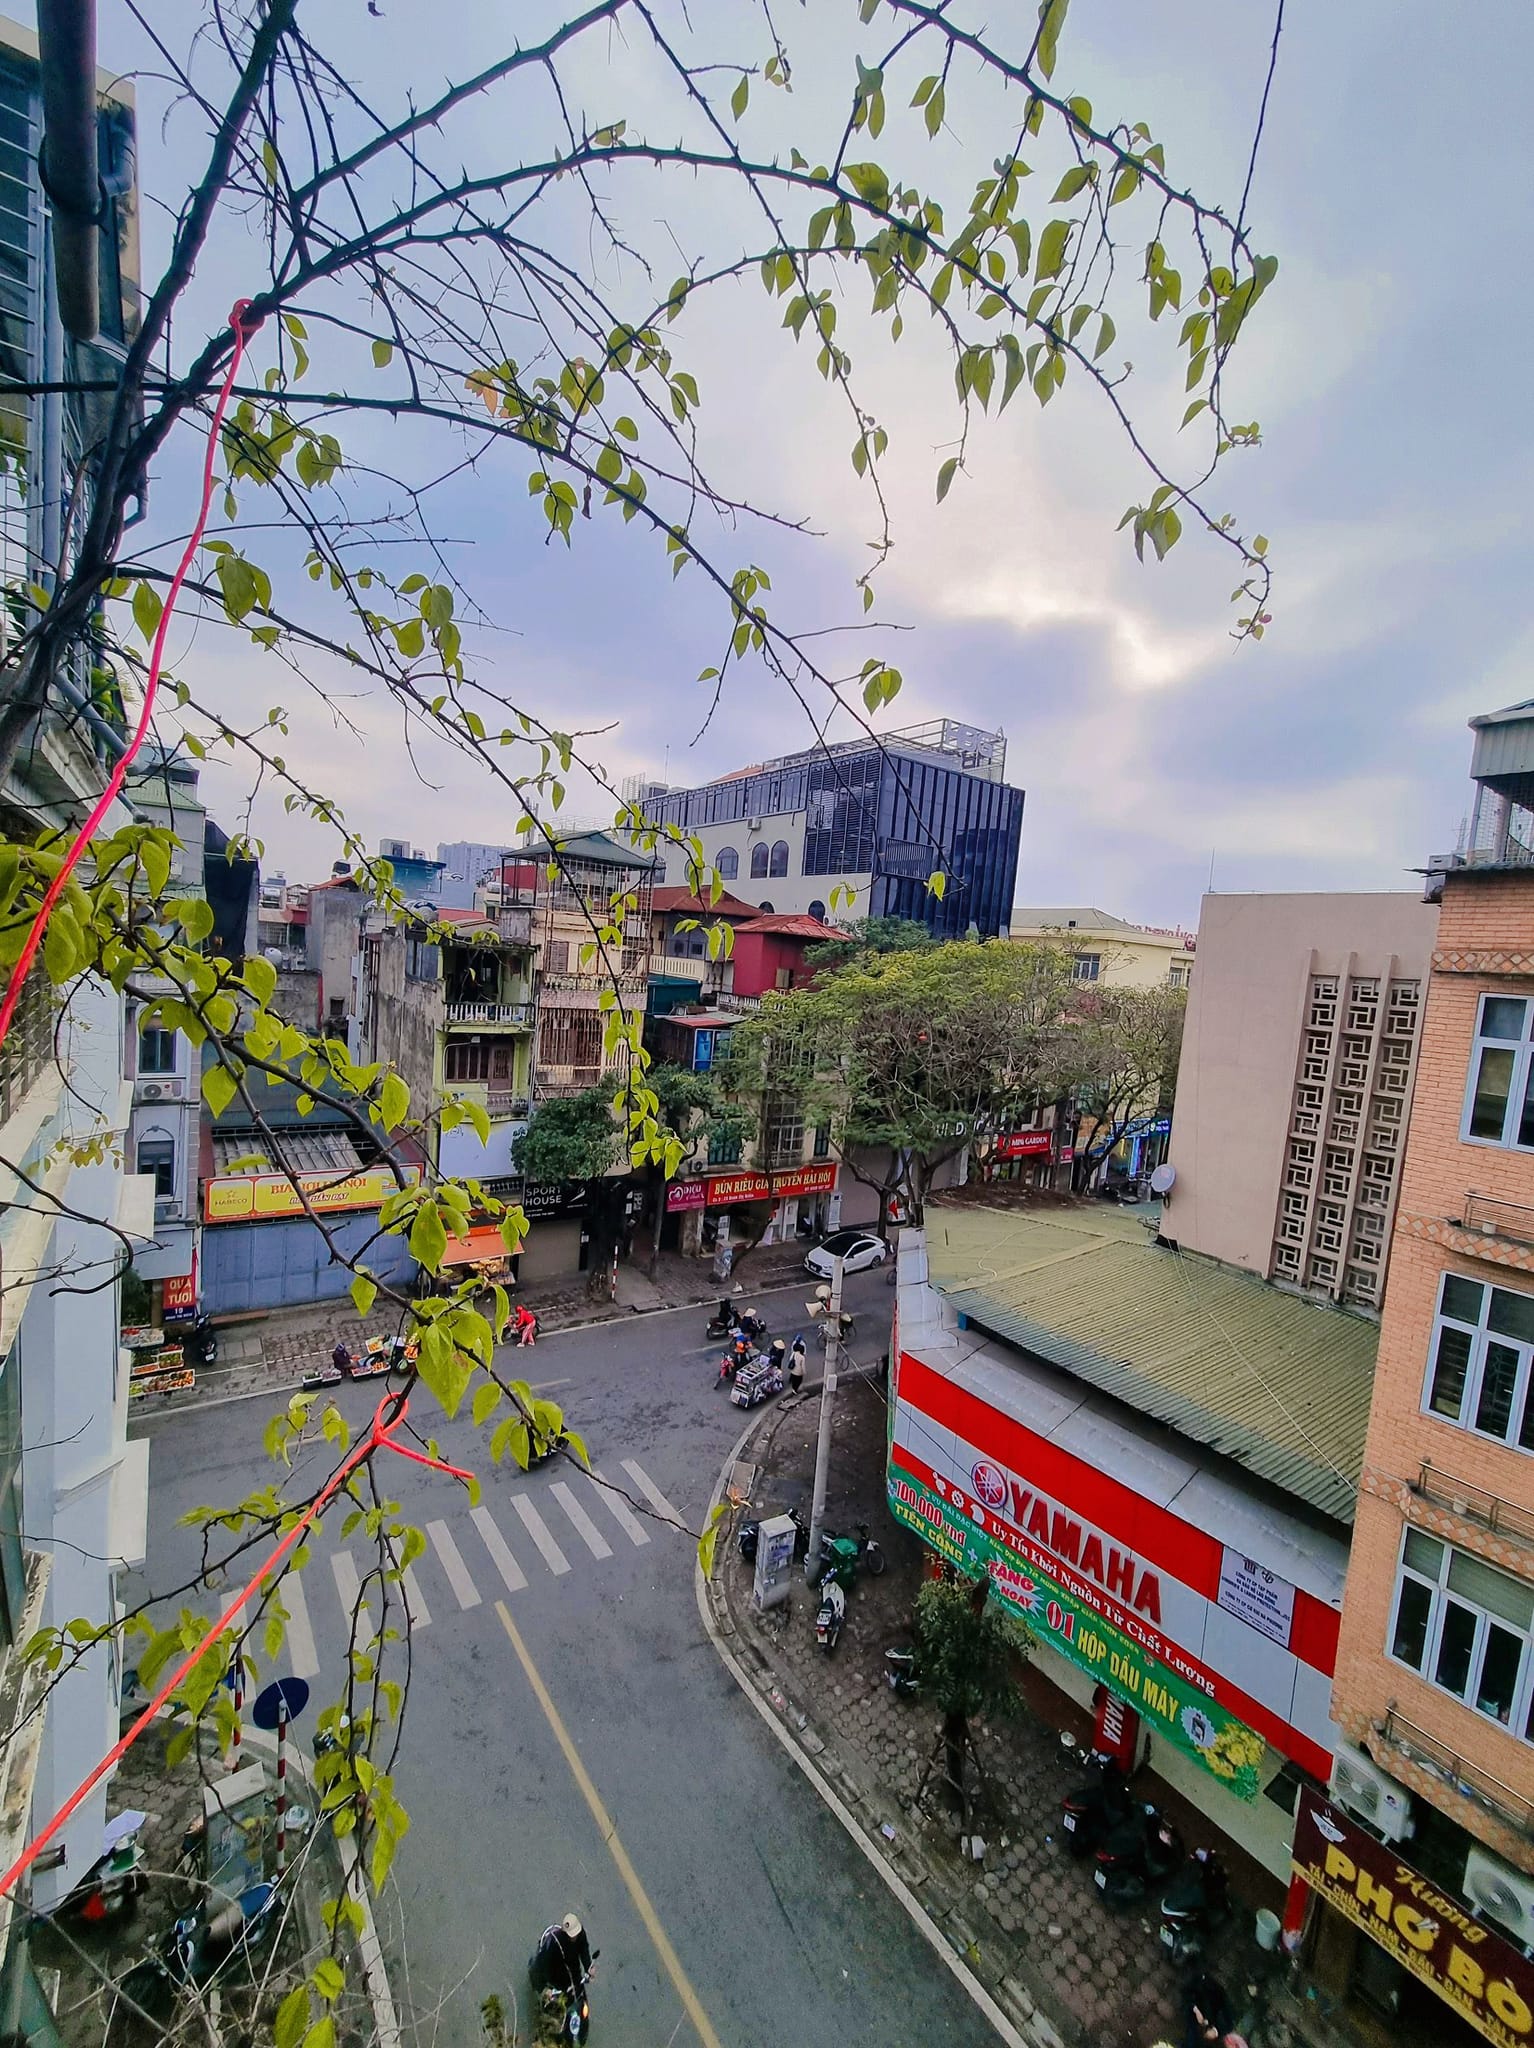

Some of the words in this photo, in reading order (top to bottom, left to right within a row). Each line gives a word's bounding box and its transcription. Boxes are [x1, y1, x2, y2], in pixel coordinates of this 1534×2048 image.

[525, 1195, 562, 1206] HOUSE
[756, 1178, 768, 1190] GIA
[896, 1480, 944, 1529] 100.000
[928, 1529, 963, 1562] CÔNG
[1010, 1480, 1162, 1626] YAMAHA
[992, 1522, 1008, 1541] Uy
[1010, 1534, 1028, 1557] Tín
[1031, 1548, 1058, 1578] Khởi
[1061, 1570, 1101, 1610] Nguồn
[1104, 1602, 1124, 1626] Từ
[1126, 1620, 1162, 1654] Chất
[1164, 1646, 1216, 1698] Lượng
[1001, 1585, 1032, 1608] NGAY
[1046, 1600, 1075, 1646] 01
[1078, 1626, 1106, 1664] HỘP
[1142, 1676, 1180, 1723] MÁY
[1448, 1943, 1532, 2033] BÒ
